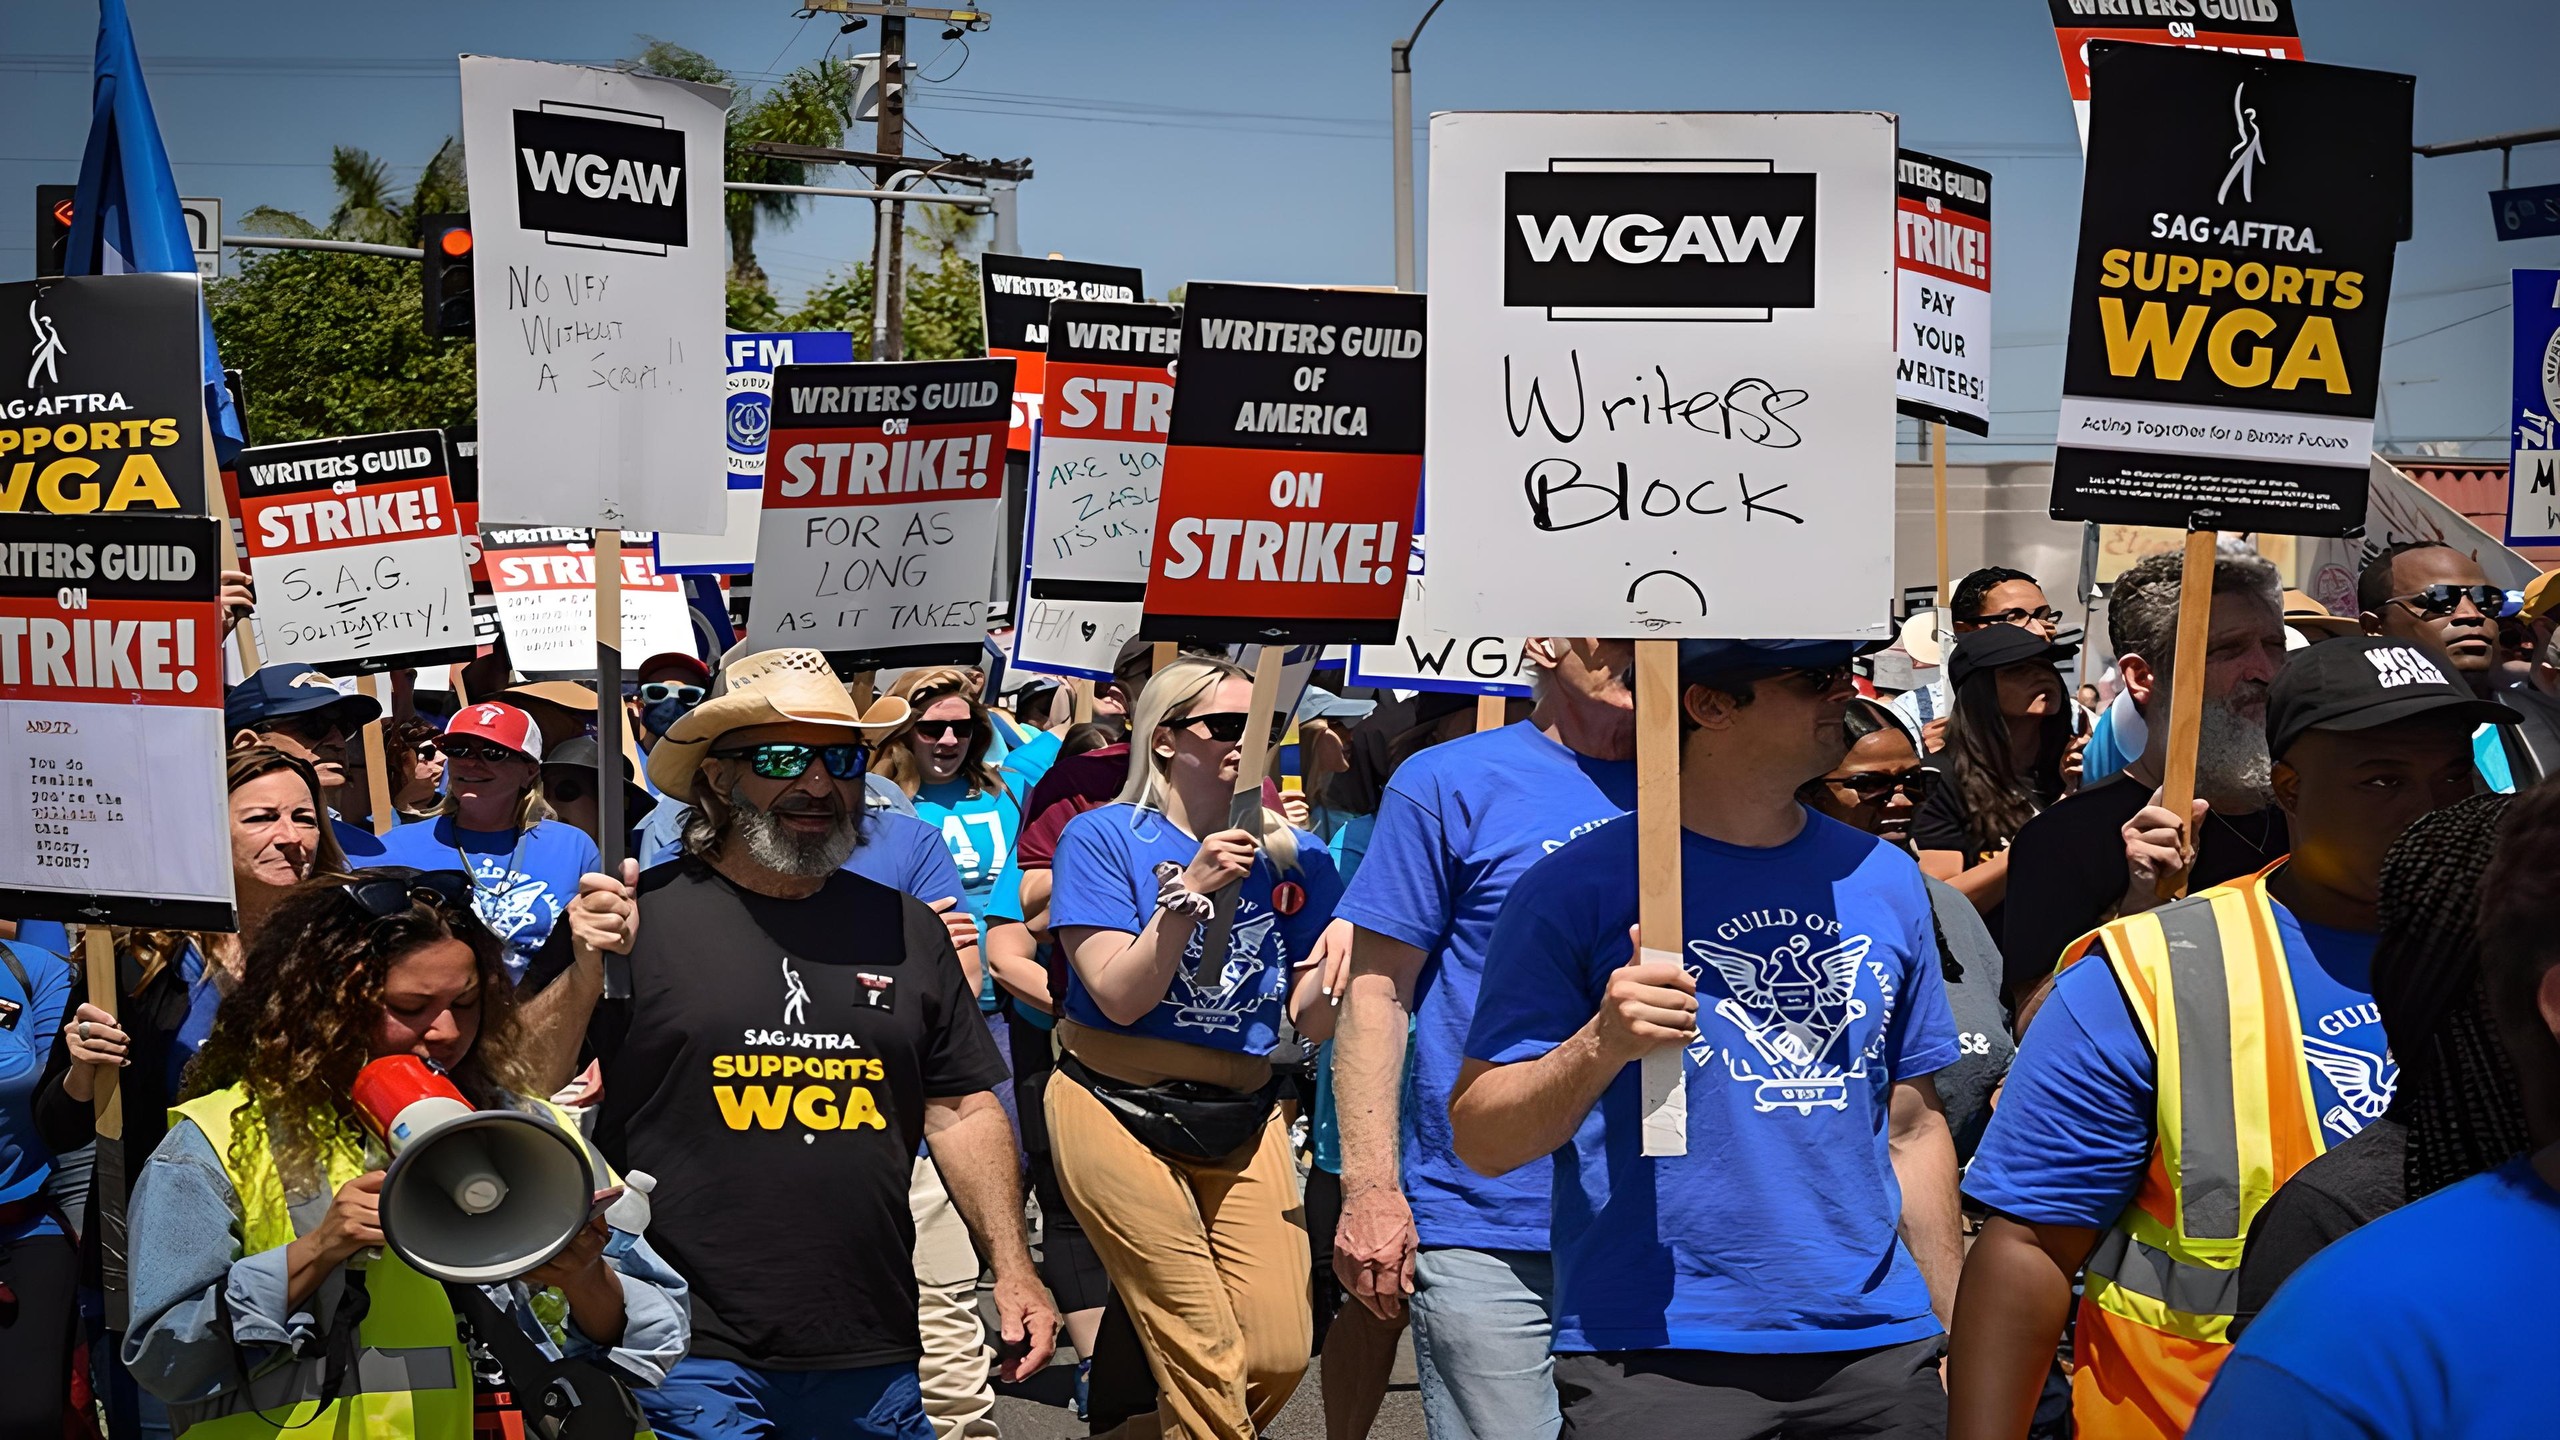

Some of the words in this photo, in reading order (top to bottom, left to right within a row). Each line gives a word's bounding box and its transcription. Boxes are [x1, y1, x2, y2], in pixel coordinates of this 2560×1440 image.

[2200, 0, 2279, 23] GUILD
[2168, 21, 2196, 39] ON
[521, 147, 681, 207] WGAW
[1945, 170, 1986, 204] GUILD
[1516, 213, 1804, 265] WGAW
[509, 265, 550, 310] NO
[991, 273, 1078, 300] WRITERS
[2100, 248, 2365, 310] SUPPORTS
[1920, 286, 1955, 317] PAY
[727, 339, 794, 368] FM
[1200, 317, 1336, 356] WRITERS
[1341, 325, 1424, 360] GUILD
[1913, 322, 1966, 358] YOUR
[2098, 296, 2352, 395] WGA
[538, 363, 559, 393] A
[1293, 366, 1327, 392] OF
[790, 384, 918, 414] WRITERS
[921, 381, 999, 410] GUILD
[882, 417, 910, 436] ON
[1234, 401, 1368, 437] AMERICA
[249, 454, 360, 487] WRITERS
[361, 446, 432, 474] GUILD
[780, 434, 993, 498] STRIKE!
[1269, 470, 1324, 508] ON
[1525, 456, 1805, 531] Block
[257, 486, 442, 548] STRIKE!
[806, 514, 881, 549] FOR
[902, 511, 954, 547] AS
[101, 543, 197, 582] GUILD
[1163, 516, 1399, 586] STRIKE!
[282, 555, 410, 602] S.A.G.
[499, 555, 665, 587] STRIE!
[815, 553, 928, 598] LONG
[57, 587, 88, 610] ON
[776, 611, 817, 633] AS
[838, 608, 868, 627] IT
[890, 600, 987, 630] TAKES
[2364, 647, 2437, 673] WGA
[1716, 908, 1798, 941] GUILD
[1804, 913, 1844, 938] OF
[712, 1055, 885, 1081] SUPPORTS
[712, 1085, 887, 1131] WGA
